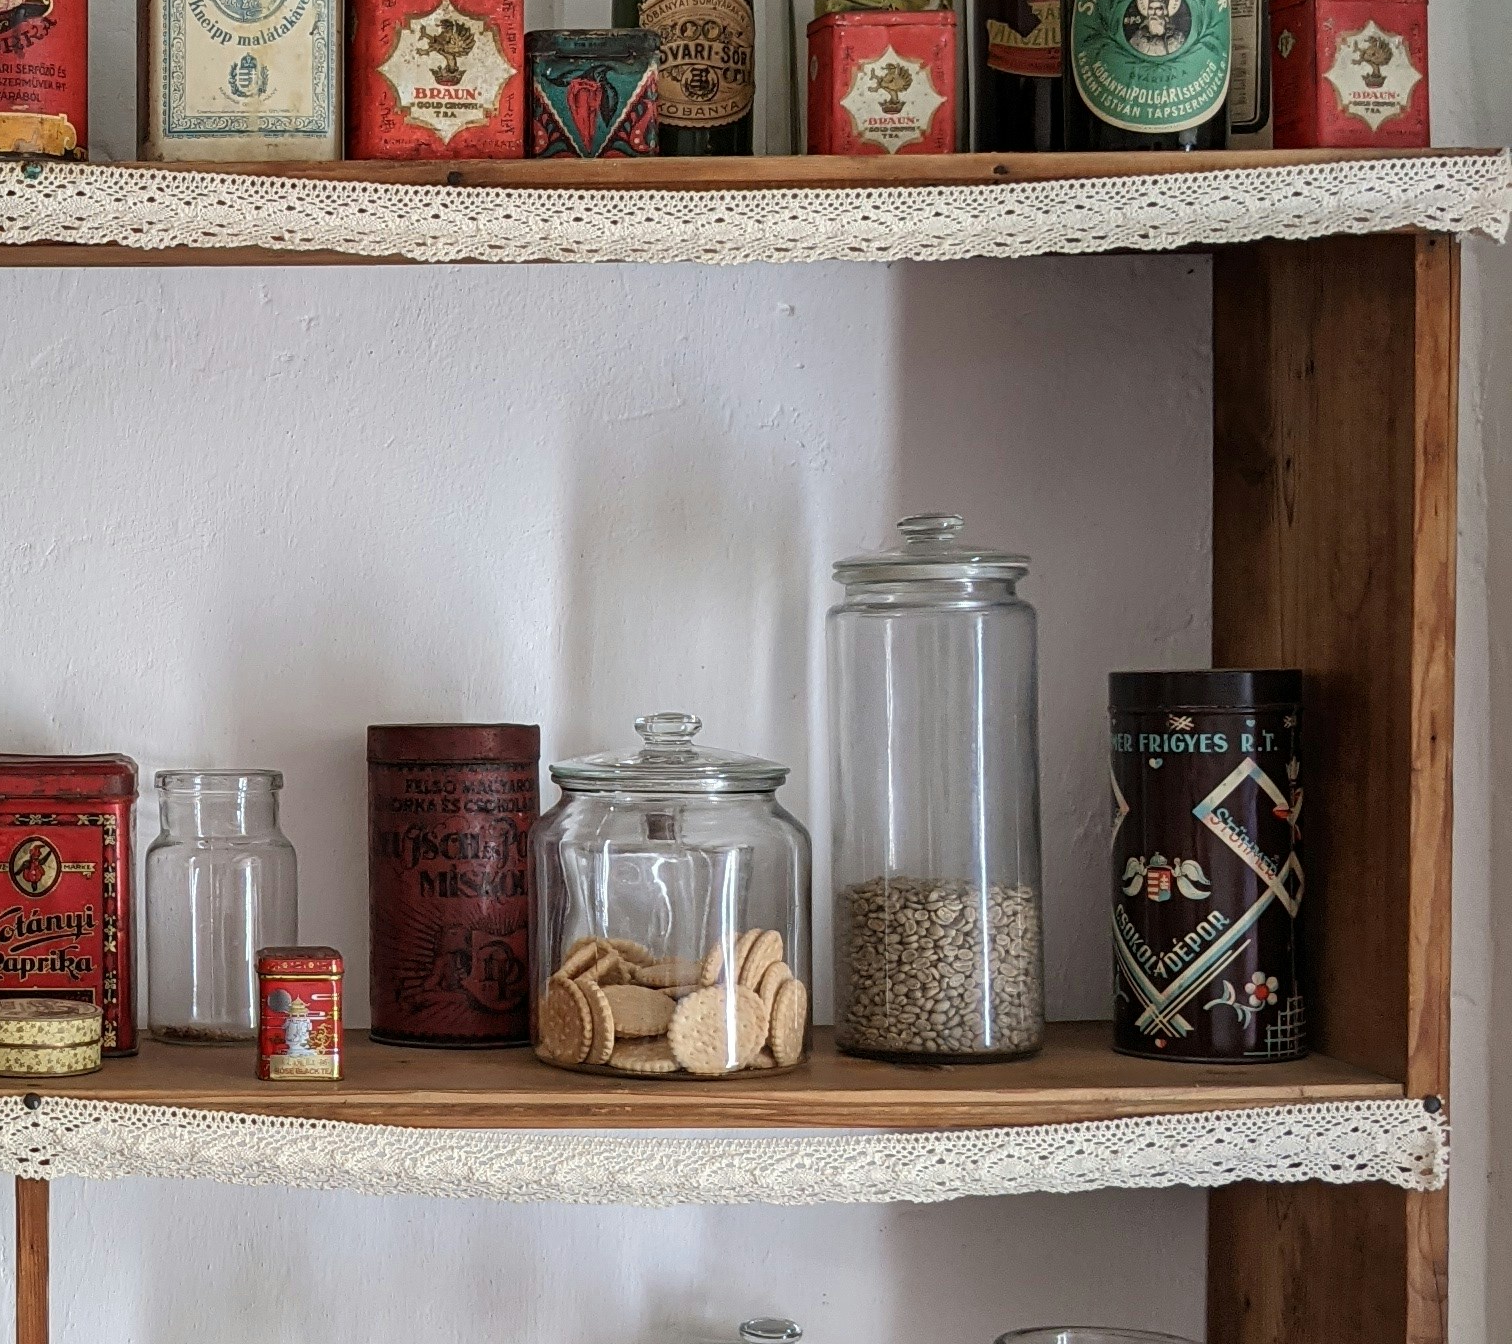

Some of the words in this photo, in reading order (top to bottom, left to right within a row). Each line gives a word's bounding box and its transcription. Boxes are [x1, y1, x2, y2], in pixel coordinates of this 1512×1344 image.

[659, 43, 747, 67] DVARI-SÖR
[414, 86, 477, 101] BRAUN
[1352, 90, 1397, 100] BRAUN
[433, 110, 457, 118] TEA
[867, 116, 916, 126] BRAUN
[1139, 733, 1229, 753] FRIGYES
[1115, 903, 1230, 978] CSOKOLÁDÉPOR
